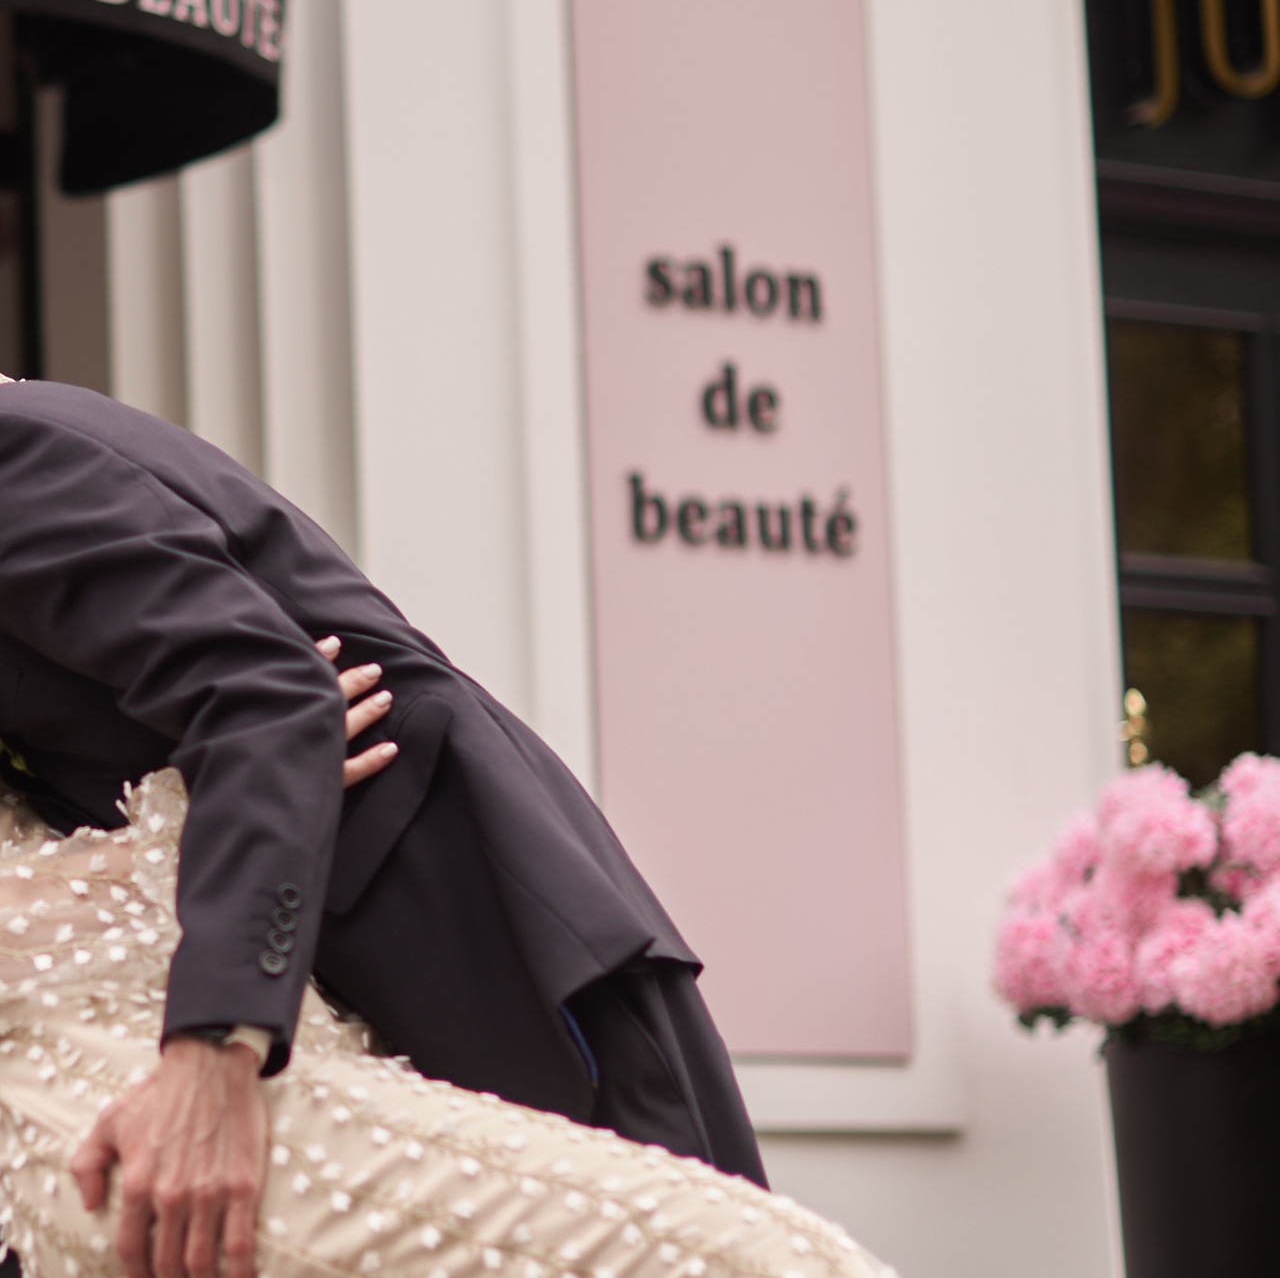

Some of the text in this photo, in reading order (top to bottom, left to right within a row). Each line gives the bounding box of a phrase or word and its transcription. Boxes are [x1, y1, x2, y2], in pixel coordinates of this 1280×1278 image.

[644, 242, 824, 324] salon
[700, 361, 780, 435] de
[627, 468, 859, 559] beauté
